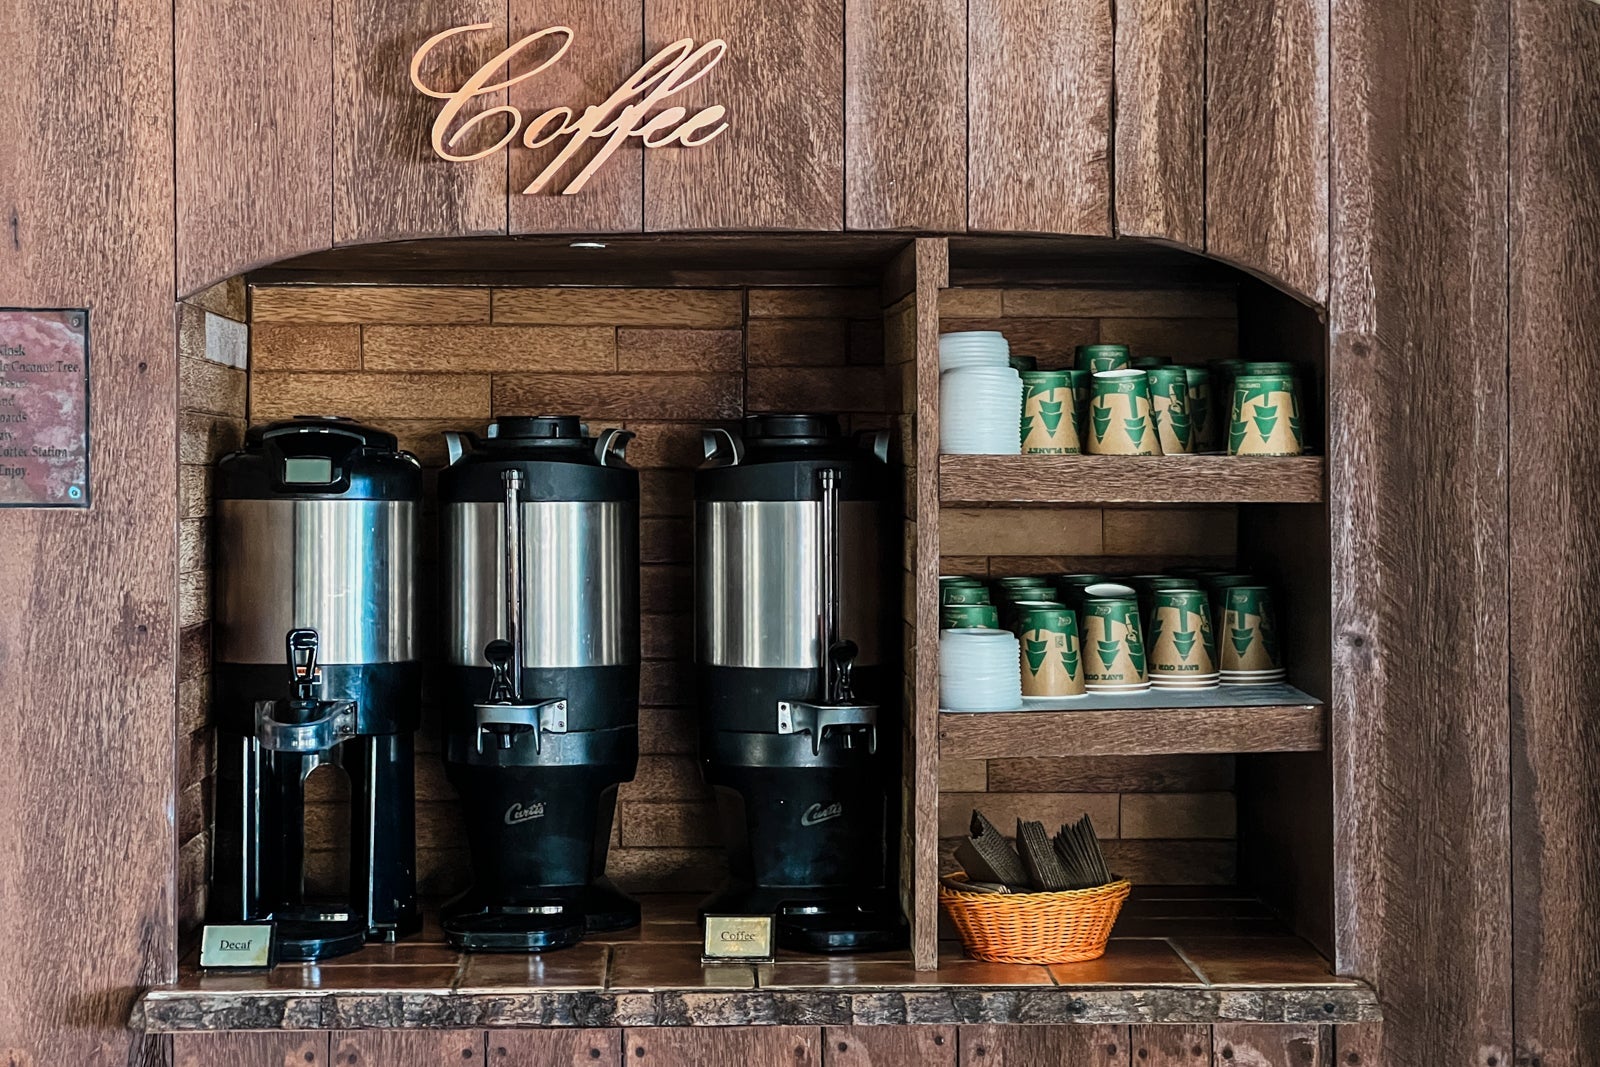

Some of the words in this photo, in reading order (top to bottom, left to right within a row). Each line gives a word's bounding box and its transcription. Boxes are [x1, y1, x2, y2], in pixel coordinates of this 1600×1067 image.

[410, 22, 729, 195] Coffee
[31, 445, 68, 458] Station
[721, 930, 756, 942] Coffee
[219, 939, 253, 951] Decaf
